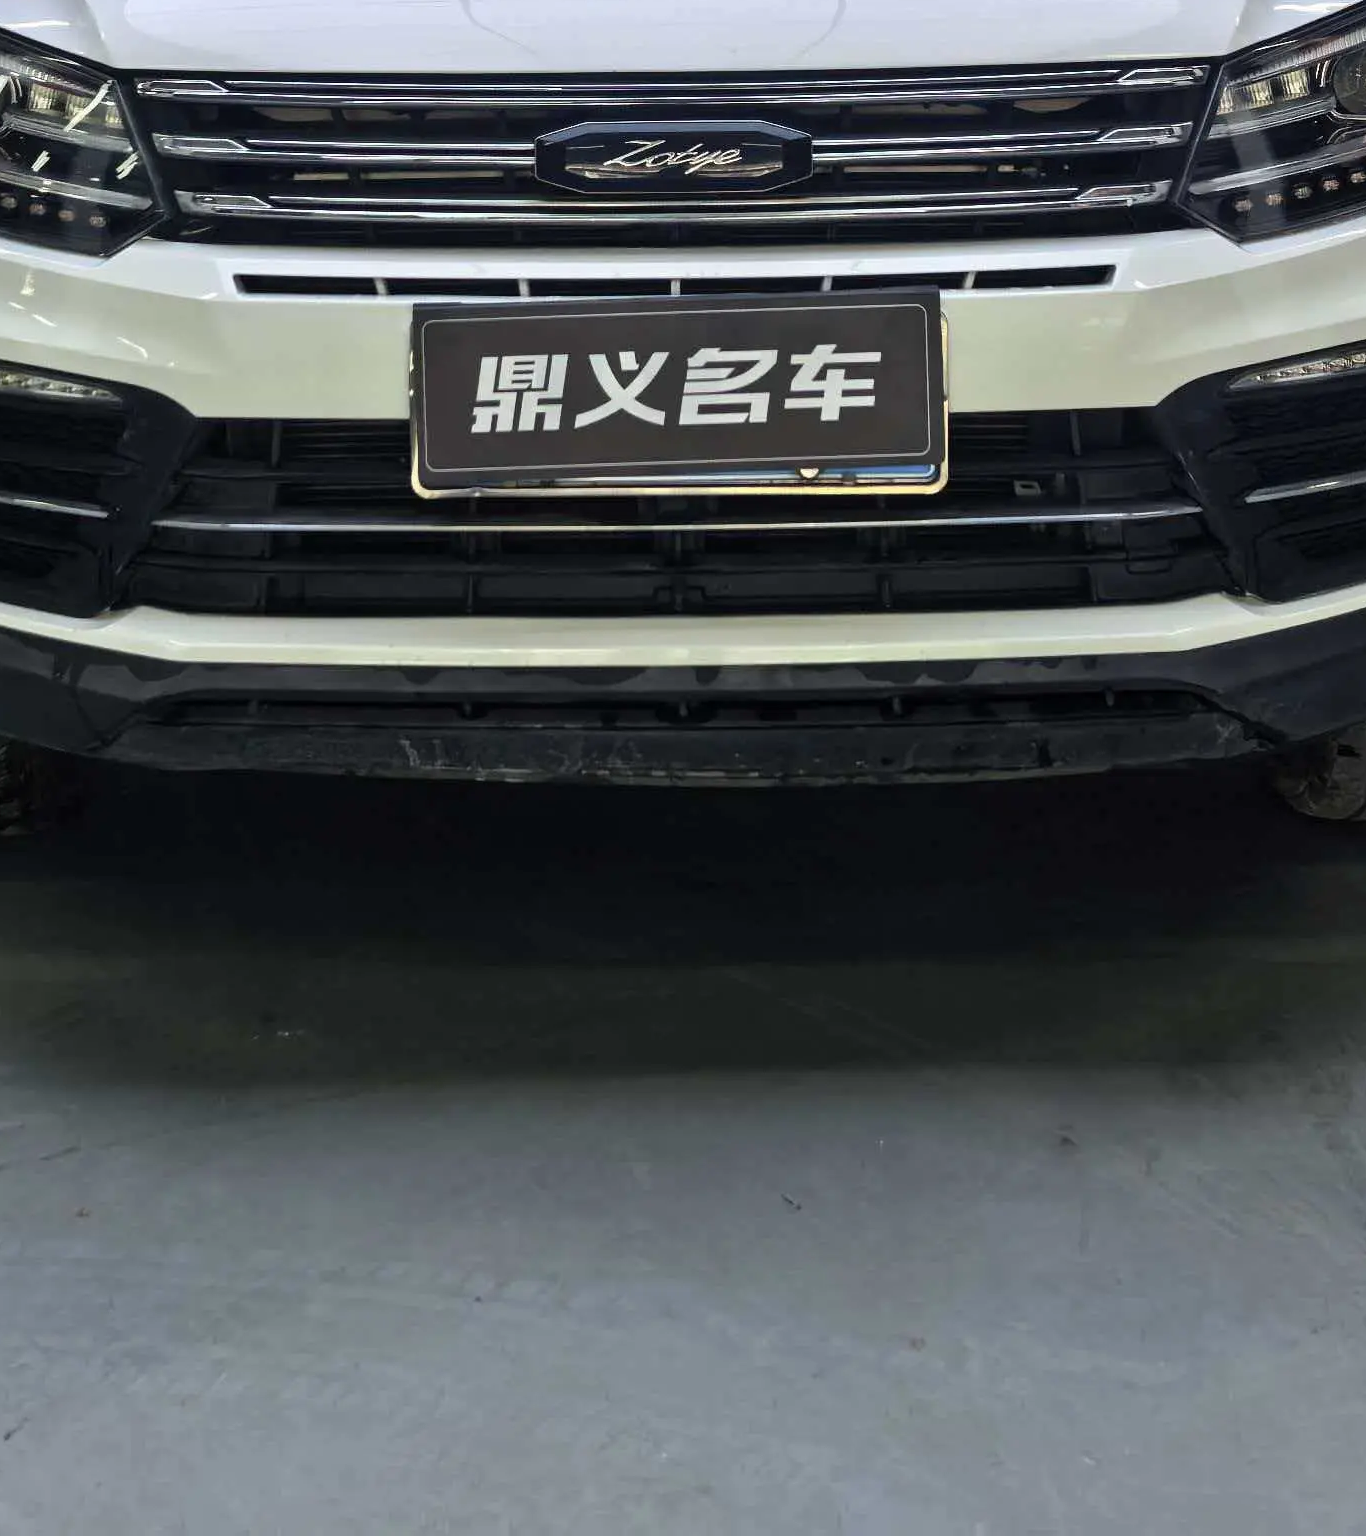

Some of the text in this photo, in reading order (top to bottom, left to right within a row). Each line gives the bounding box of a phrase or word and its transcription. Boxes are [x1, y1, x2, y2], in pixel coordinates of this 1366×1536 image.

[602, 138, 744, 175] Zotye
[471, 342, 882, 435] 鼎义名车
